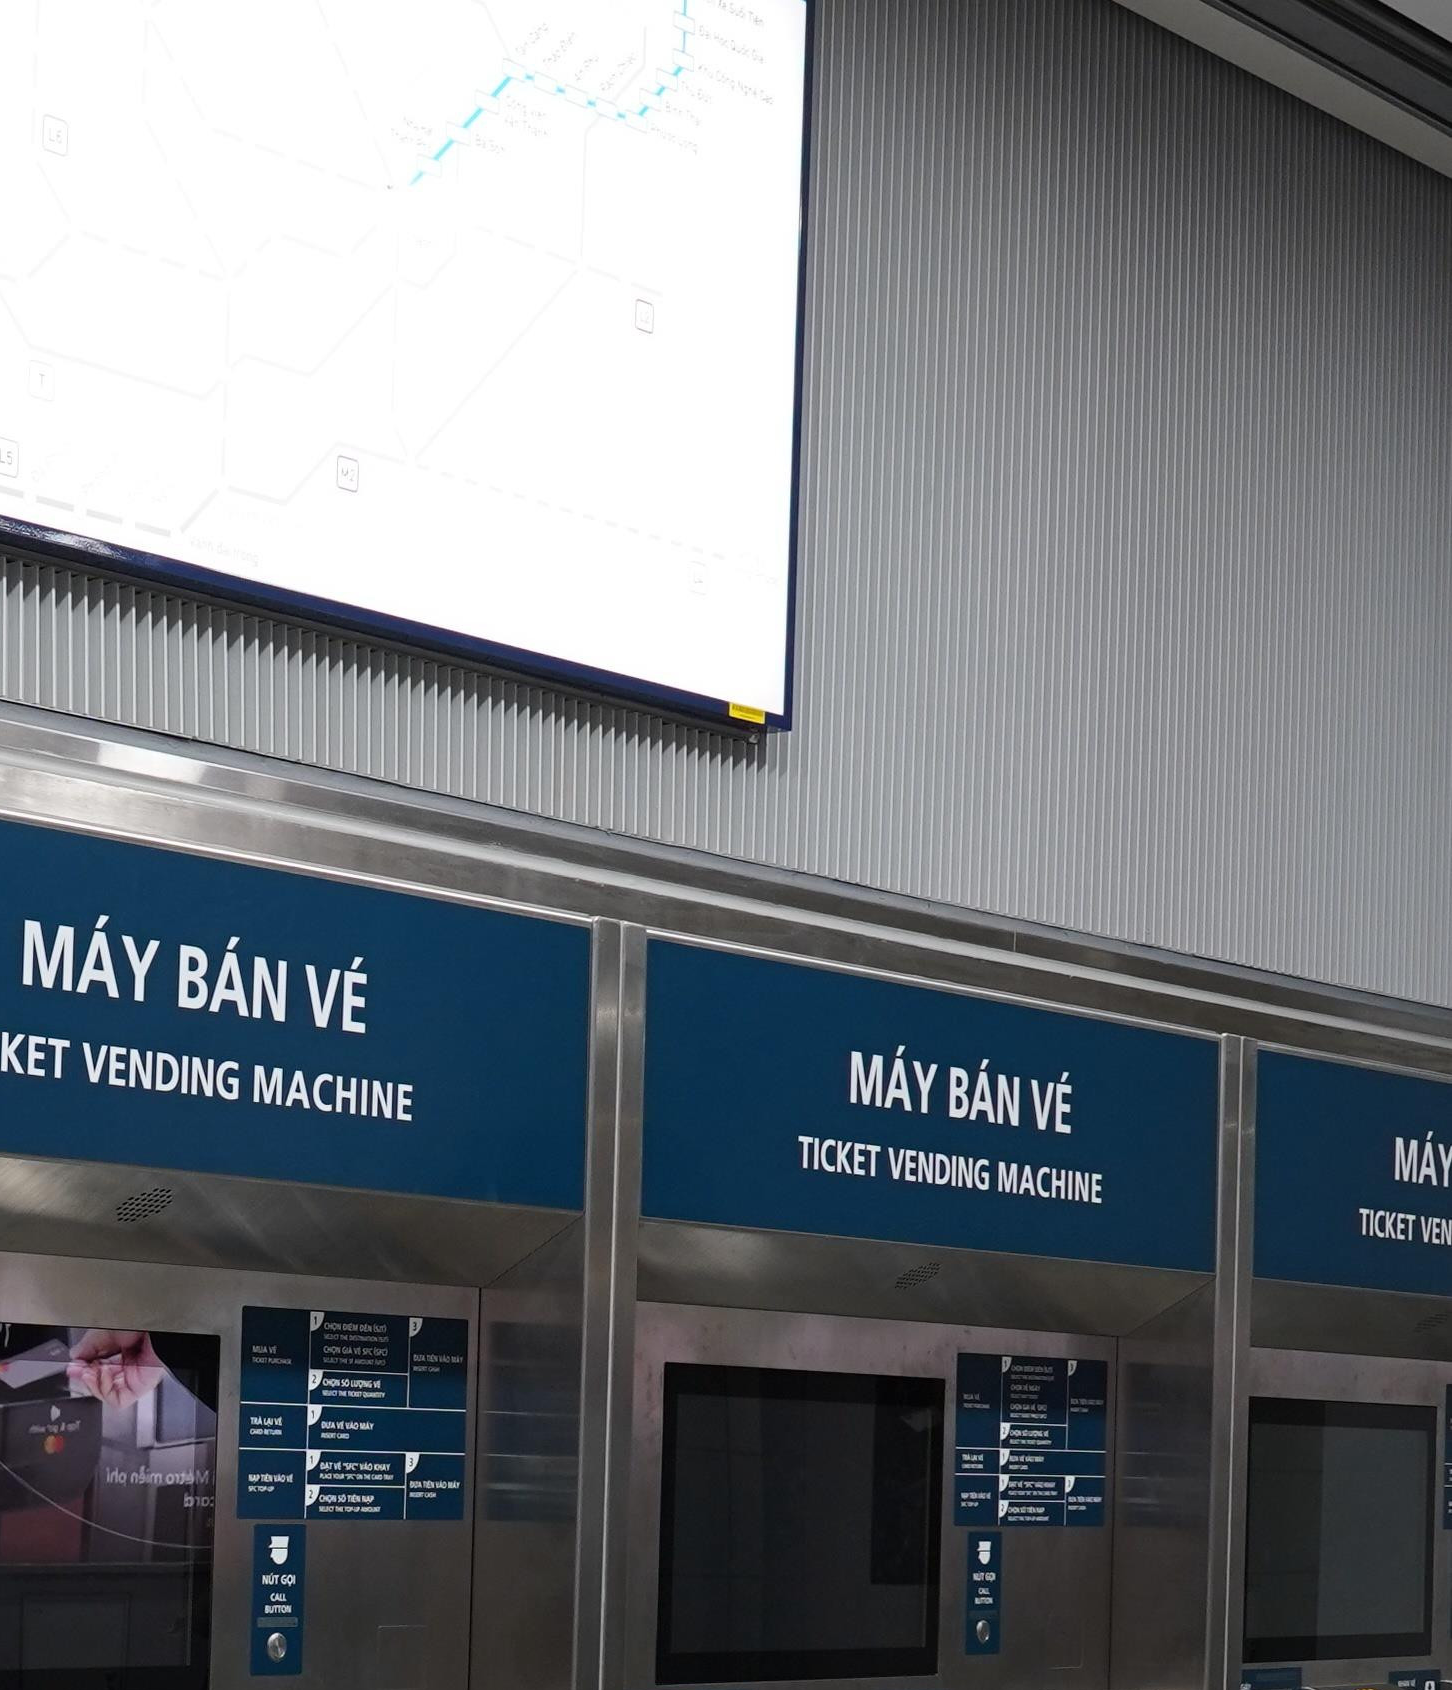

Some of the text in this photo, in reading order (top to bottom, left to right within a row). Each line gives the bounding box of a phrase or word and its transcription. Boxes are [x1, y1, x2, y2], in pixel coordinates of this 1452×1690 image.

[22, 914, 367, 1034] MÁY BÁN VÉ
[82, 1042, 239, 1100] VENDING
[253, 1065, 413, 1121] MACHINE
[850, 1045, 1072, 1134] MÁY BÁN VÉ
[798, 1135, 1102, 1204] TICKET VENDING MACHINE
[1359, 1208, 1416, 1241] TICKET
